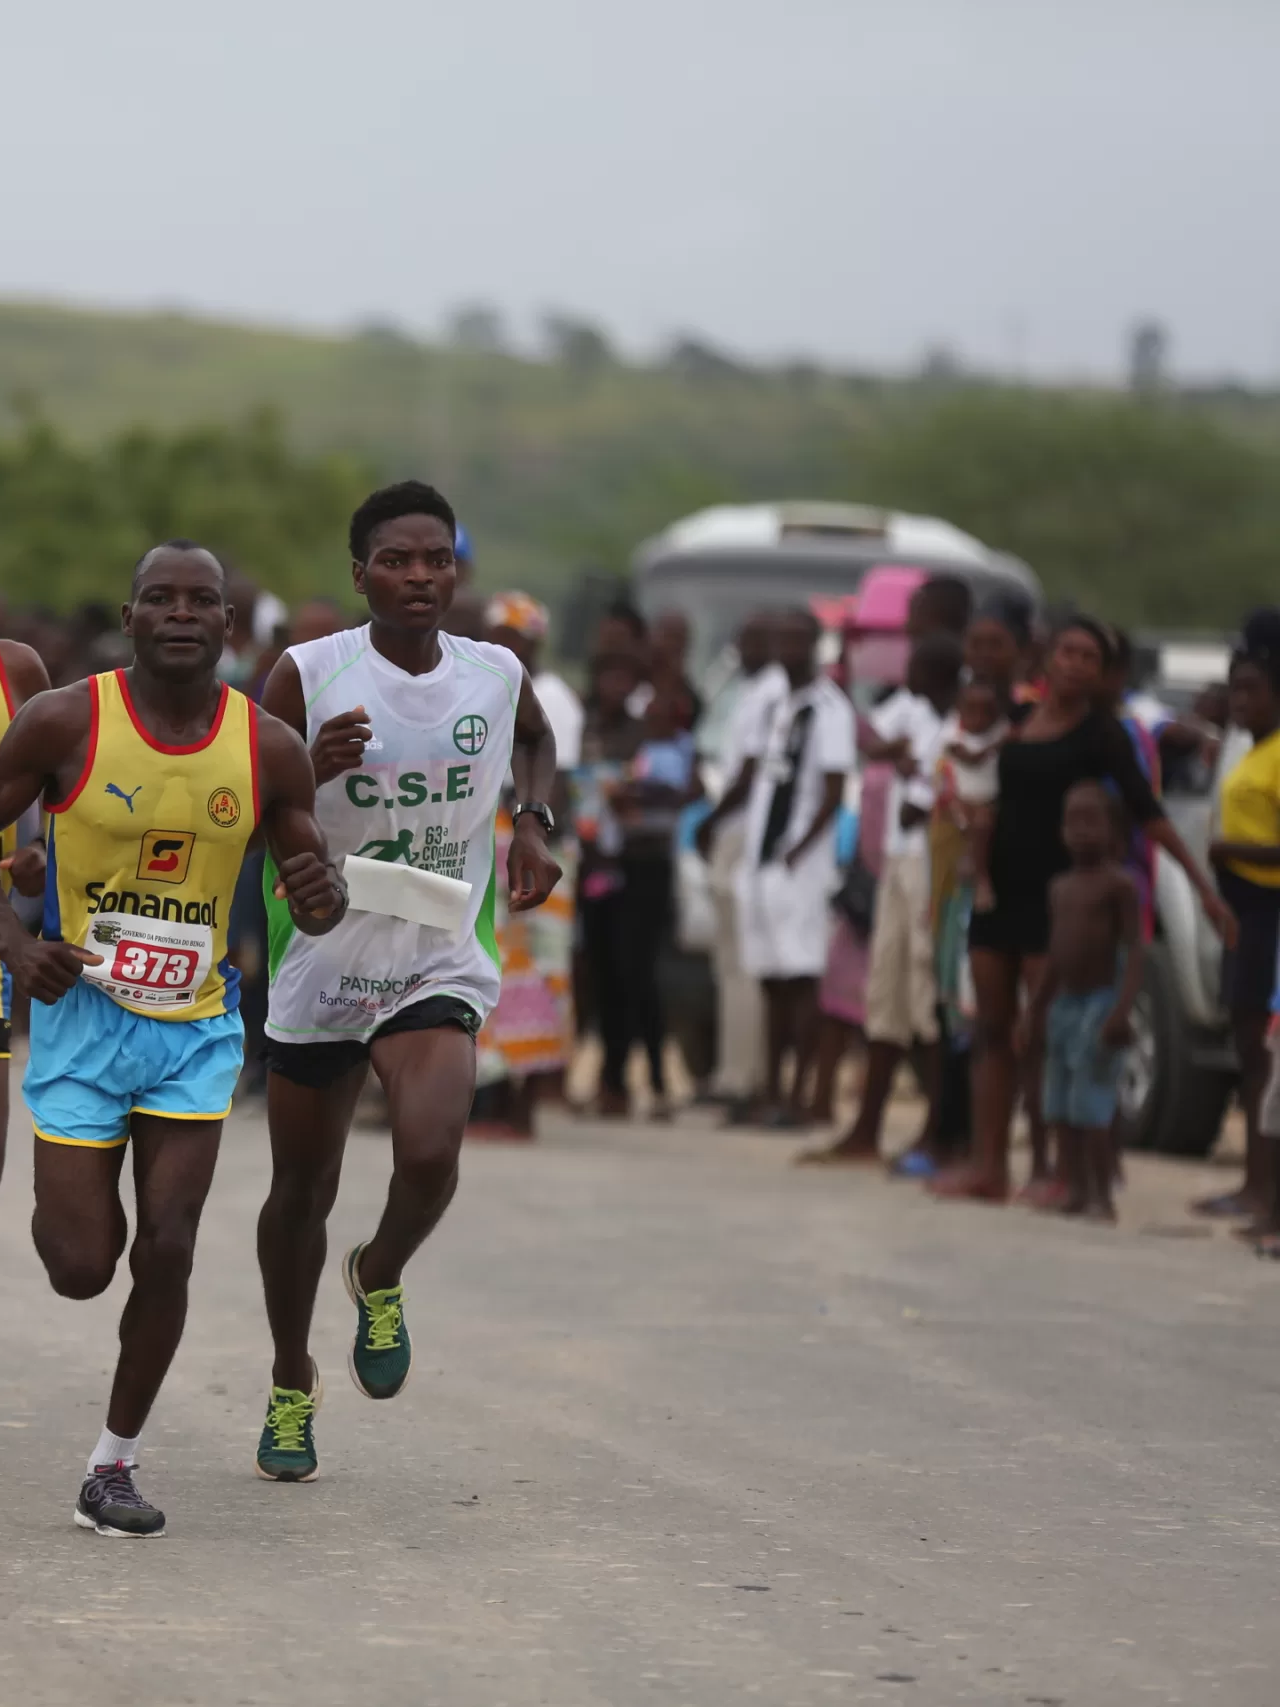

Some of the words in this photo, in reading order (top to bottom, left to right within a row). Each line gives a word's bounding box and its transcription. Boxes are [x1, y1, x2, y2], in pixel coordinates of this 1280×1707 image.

[345, 764, 475, 809] C.S.E.
[422, 841, 459, 862] COIDA
[85, 881, 218, 929] Sonangol
[121, 929, 147, 940] GOVERNO
[147, 933, 154, 941] DA
[154, 935, 181, 946] PROVÍNCIA
[189, 940, 206, 948] BENGO
[120, 946, 190, 986] 373
